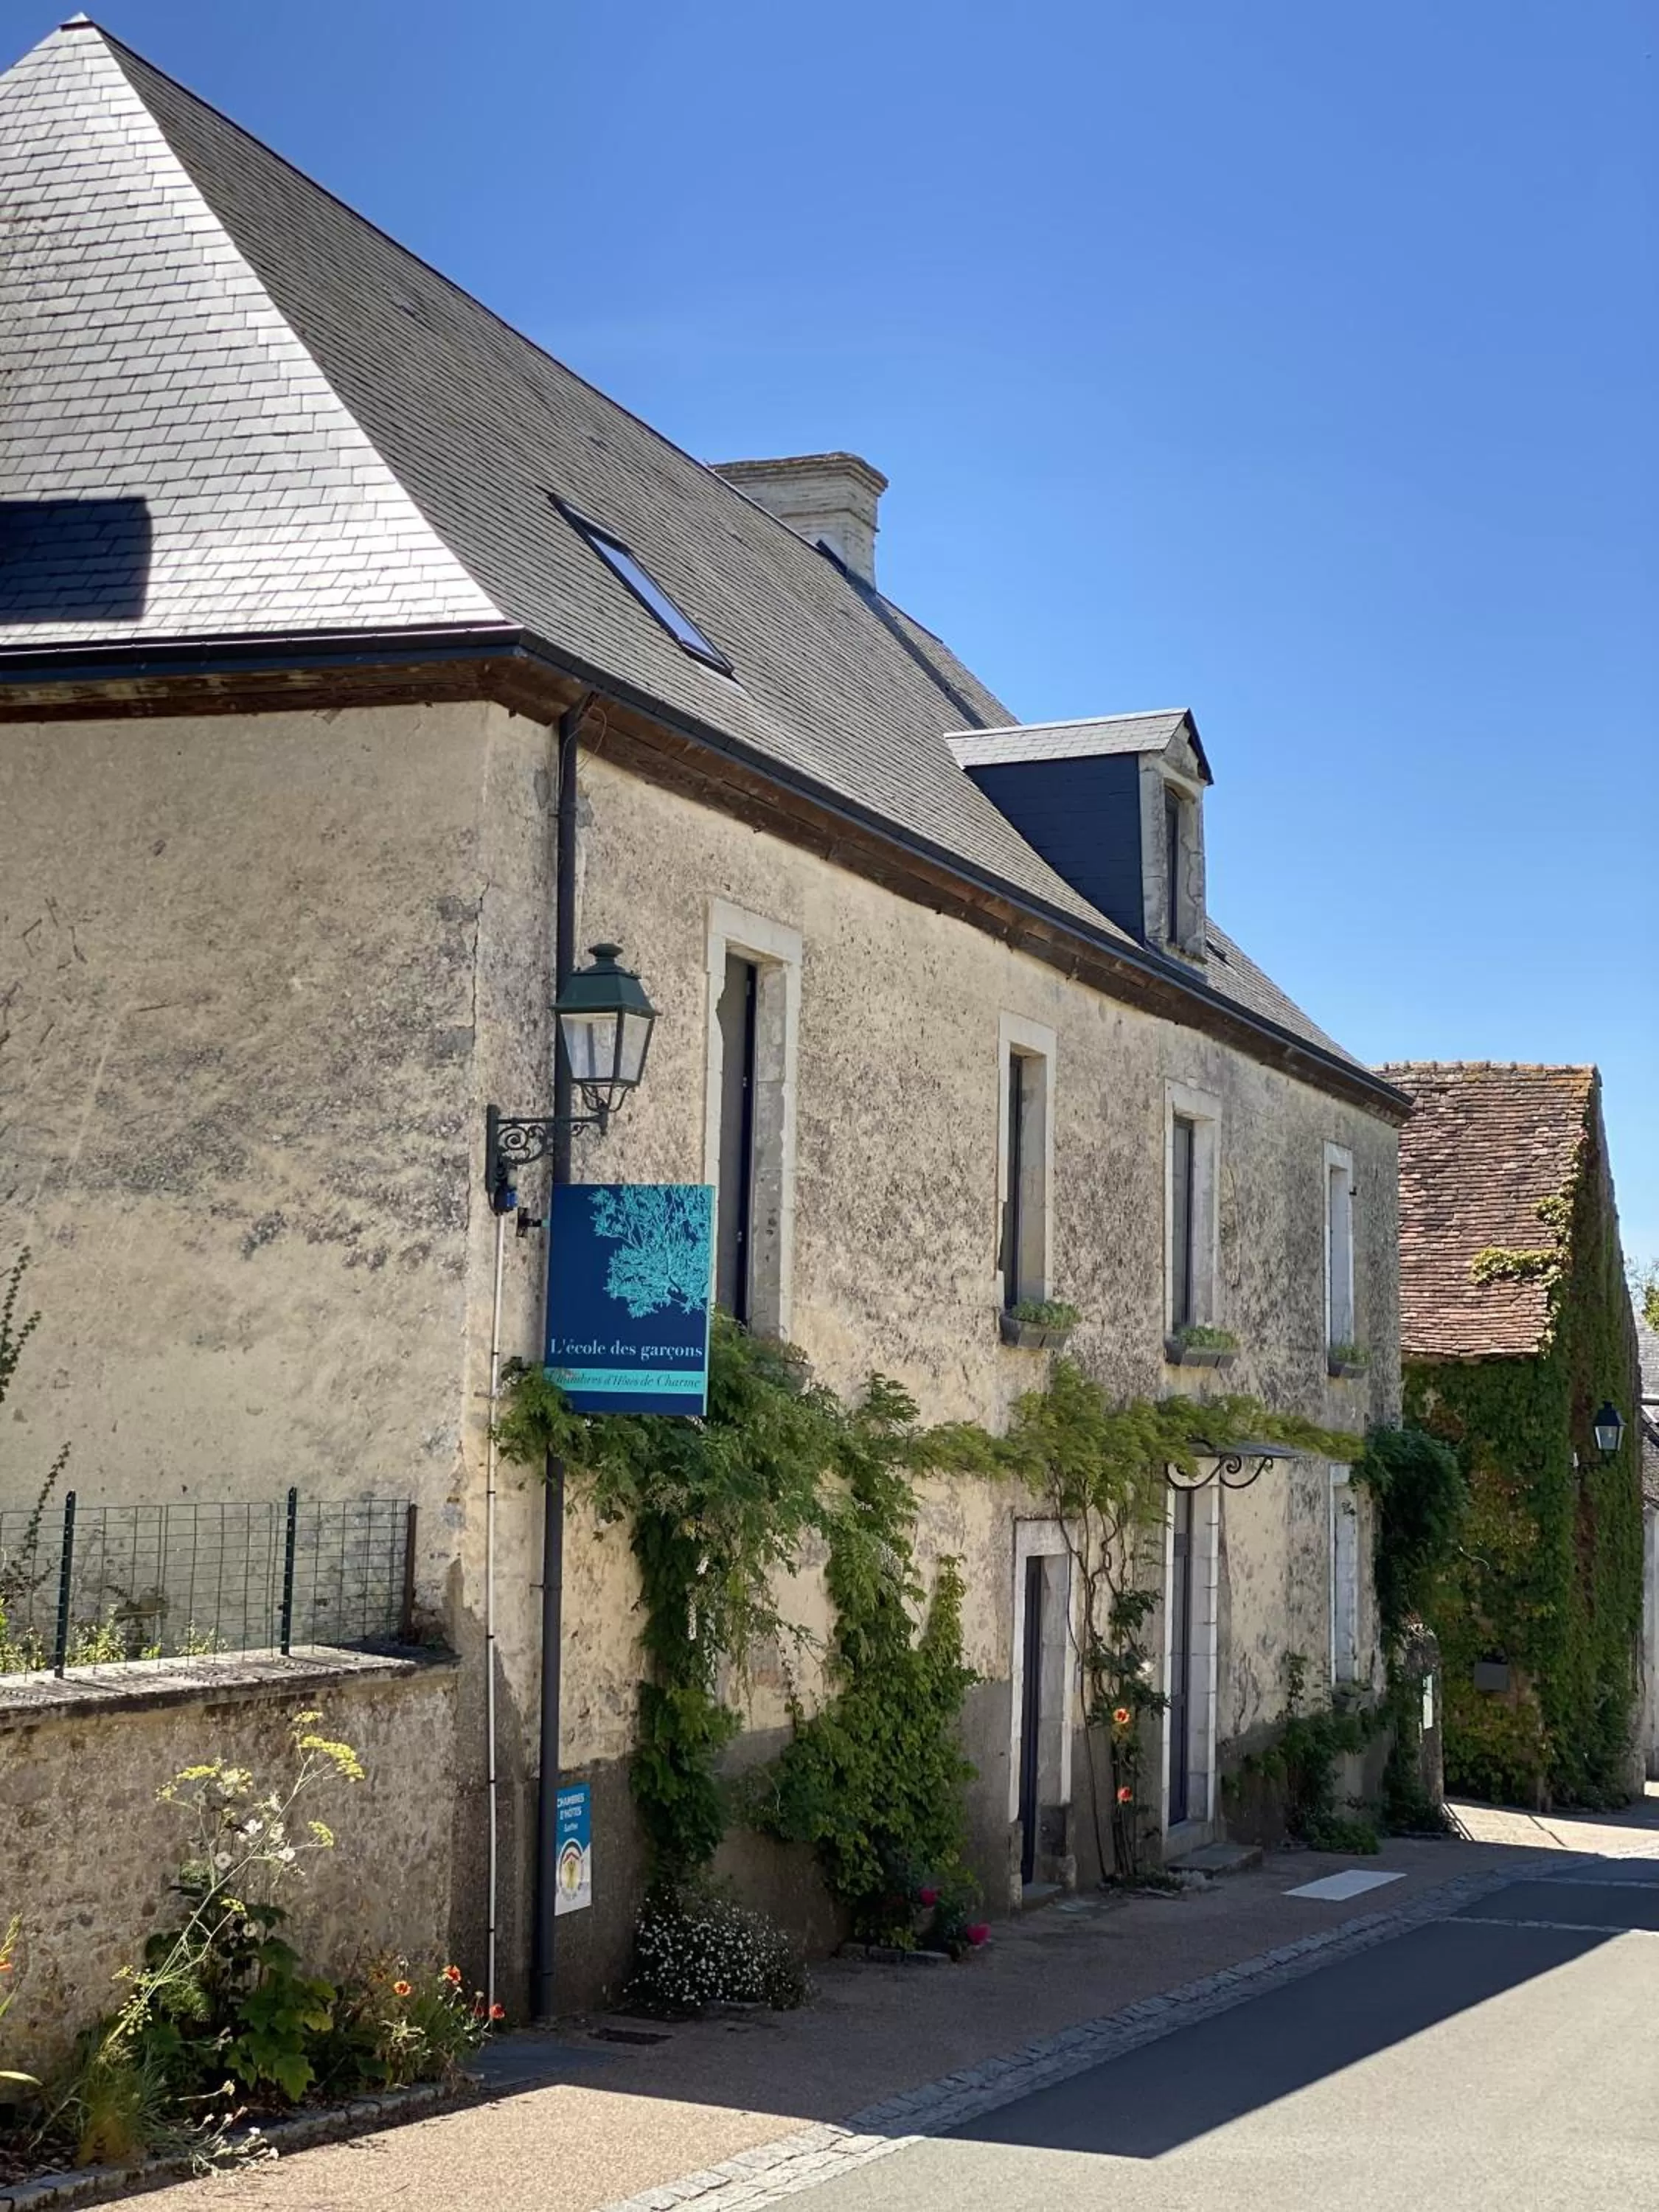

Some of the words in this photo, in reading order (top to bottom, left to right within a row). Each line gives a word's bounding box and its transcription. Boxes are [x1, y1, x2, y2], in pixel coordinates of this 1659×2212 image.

[551, 1338, 605, 1354] L'école
[611, 1340, 636, 1356] des
[641, 1346, 703, 1360] garçons
[640, 1374, 653, 1387] de
[657, 1374, 700, 1388] Charme
